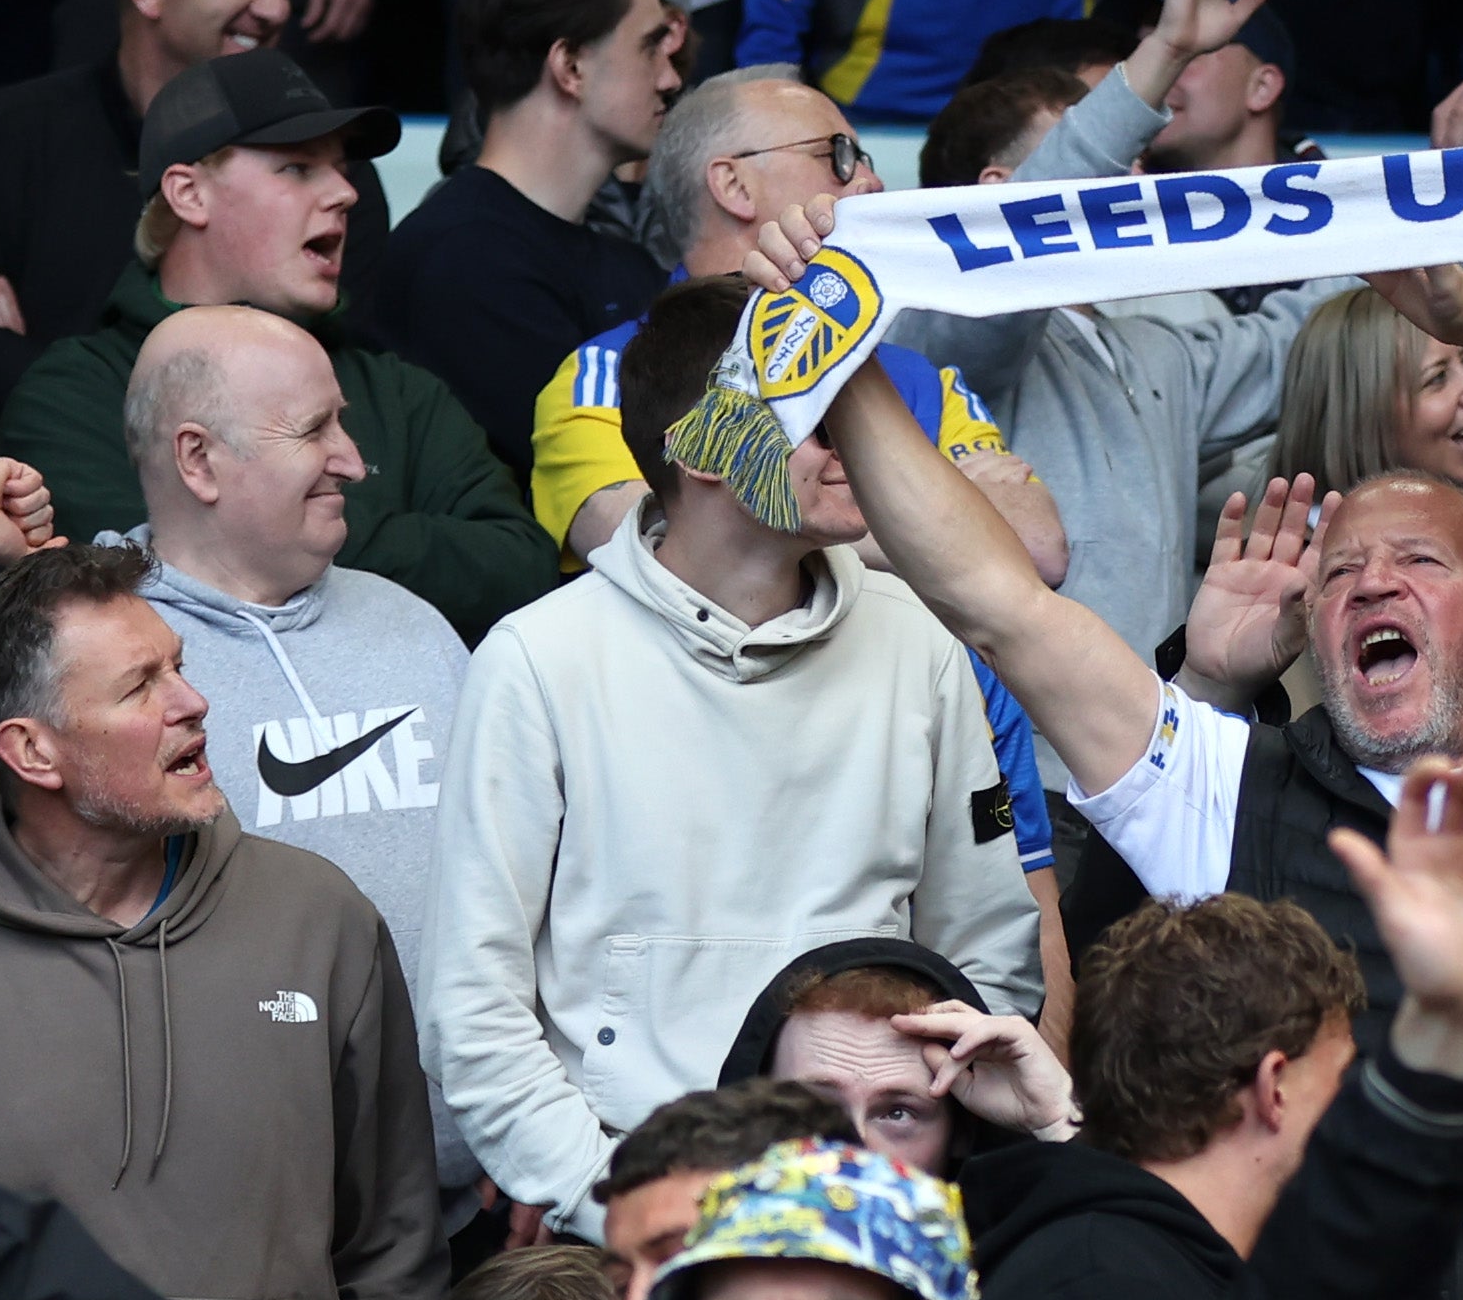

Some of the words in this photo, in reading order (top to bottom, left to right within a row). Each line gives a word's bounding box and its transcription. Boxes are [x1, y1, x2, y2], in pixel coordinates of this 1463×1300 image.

[928, 163, 1335, 273] LEEDS
[252, 704, 441, 828] NIKE
[276, 990, 295, 1002] THE
[258, 1000, 295, 1012] NORTH
[271, 1011, 295, 1023] FACE
